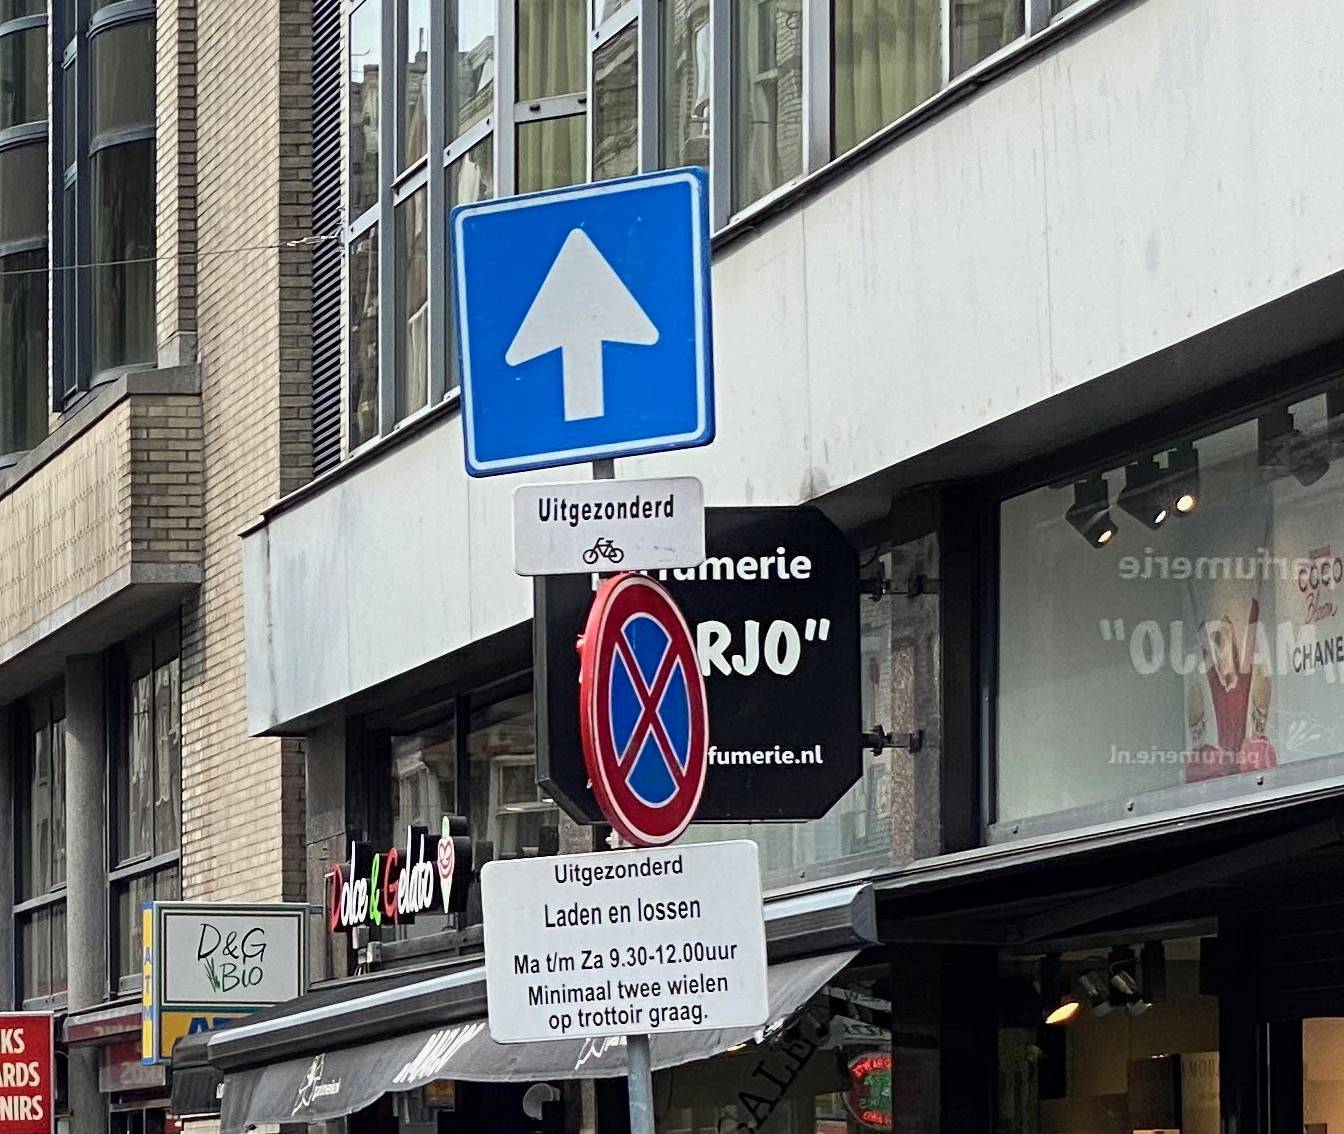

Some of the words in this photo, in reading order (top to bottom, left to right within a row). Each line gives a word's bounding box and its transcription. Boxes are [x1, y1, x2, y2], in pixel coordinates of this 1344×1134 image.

[539, 494, 674, 527] Uitgezonderd
[696, 618, 831, 676] RJO"
[707, 745, 823, 765] fumerie.nl
[331, 840, 368, 933] Dolce
[370, 853, 381, 925] &
[384, 825, 434, 917] Gelato
[554, 855, 683, 887] Uitgezonderd
[544, 902, 601, 928] Laden
[609, 906, 631, 923] en
[638, 898, 701, 921] lossen
[198, 923, 266, 963] D&G
[514, 954, 540, 975] Ma
[546, 952, 574, 973] t/m
[581, 950, 604, 969] Za
[610, 942, 737, 968] 9.30-12.00uur
[528, 980, 611, 1006] Minimaal
[618, 980, 661, 1000] twee
[667, 973, 728, 995] wielen
[549, 1012, 572, 1033] op
[578, 1005, 642, 1026] trottoir
[649, 1004, 708, 1027] graag.
